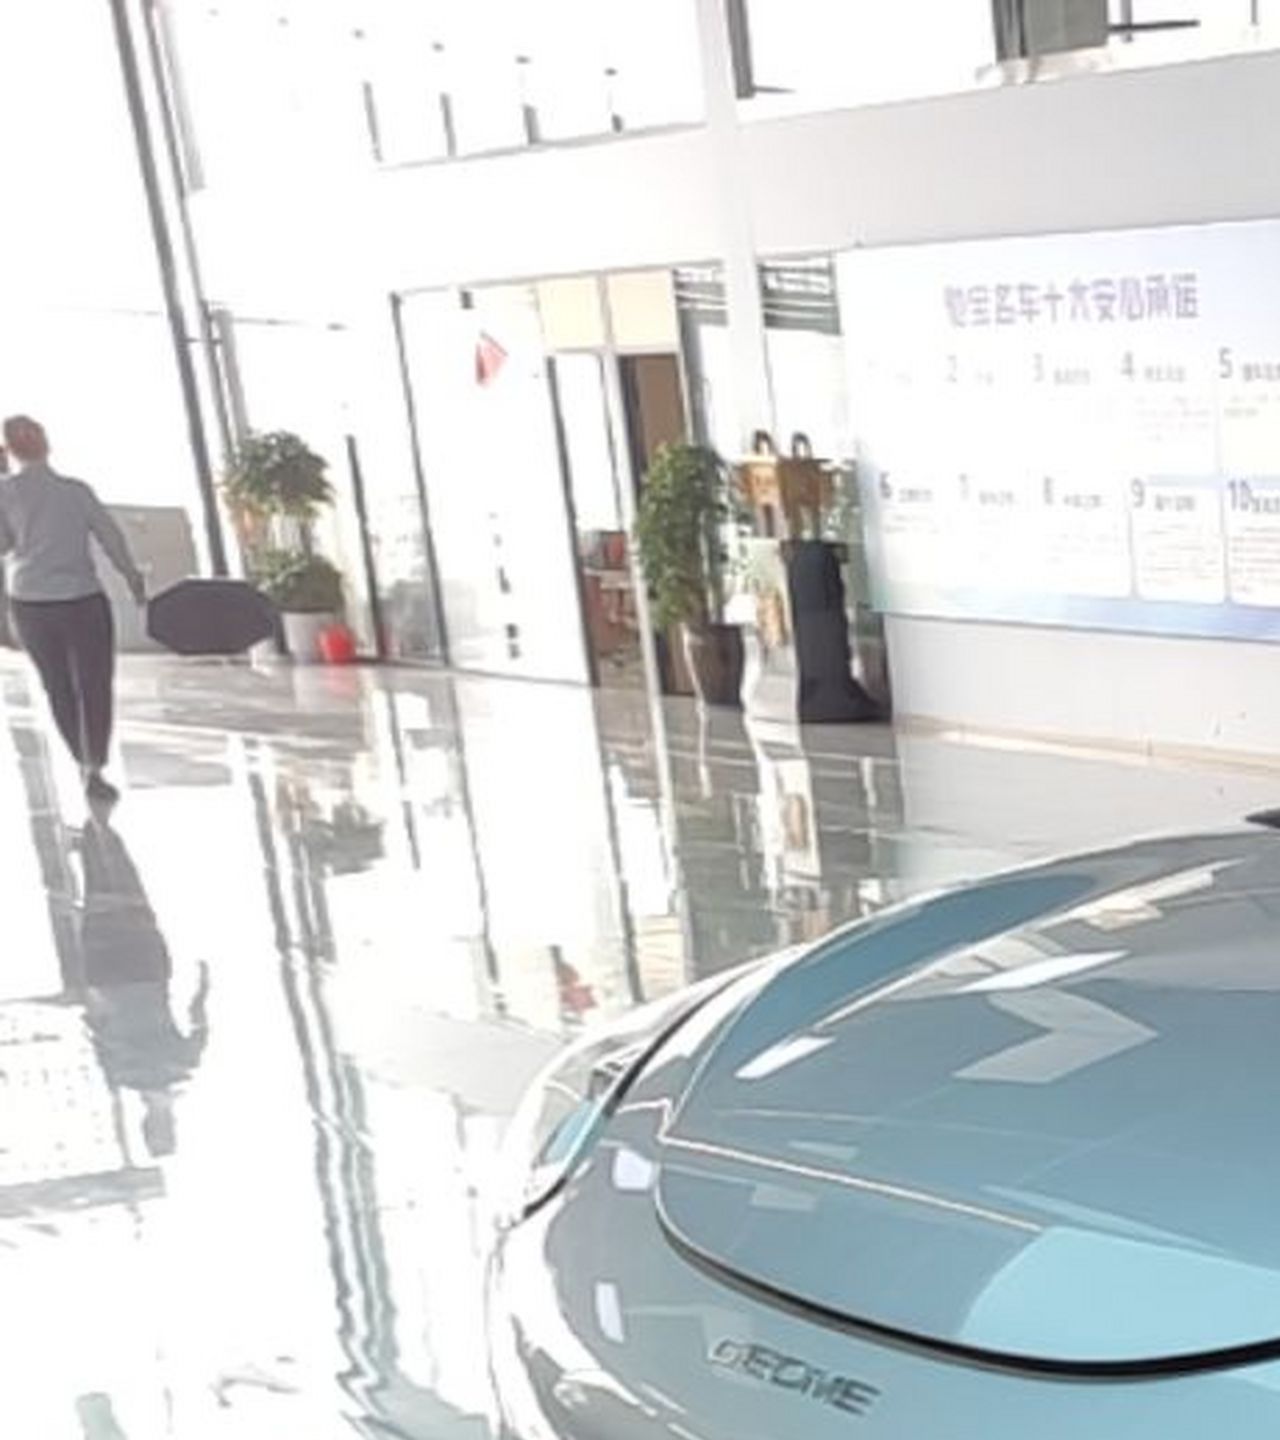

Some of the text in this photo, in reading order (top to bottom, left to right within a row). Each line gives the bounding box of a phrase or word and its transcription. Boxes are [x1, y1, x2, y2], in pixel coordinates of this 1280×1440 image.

[1120, 349, 1136, 381] 4
[1218, 346, 1234, 379] 5
[1130, 477, 1145, 508] 9
[1227, 479, 1253, 511] 10
